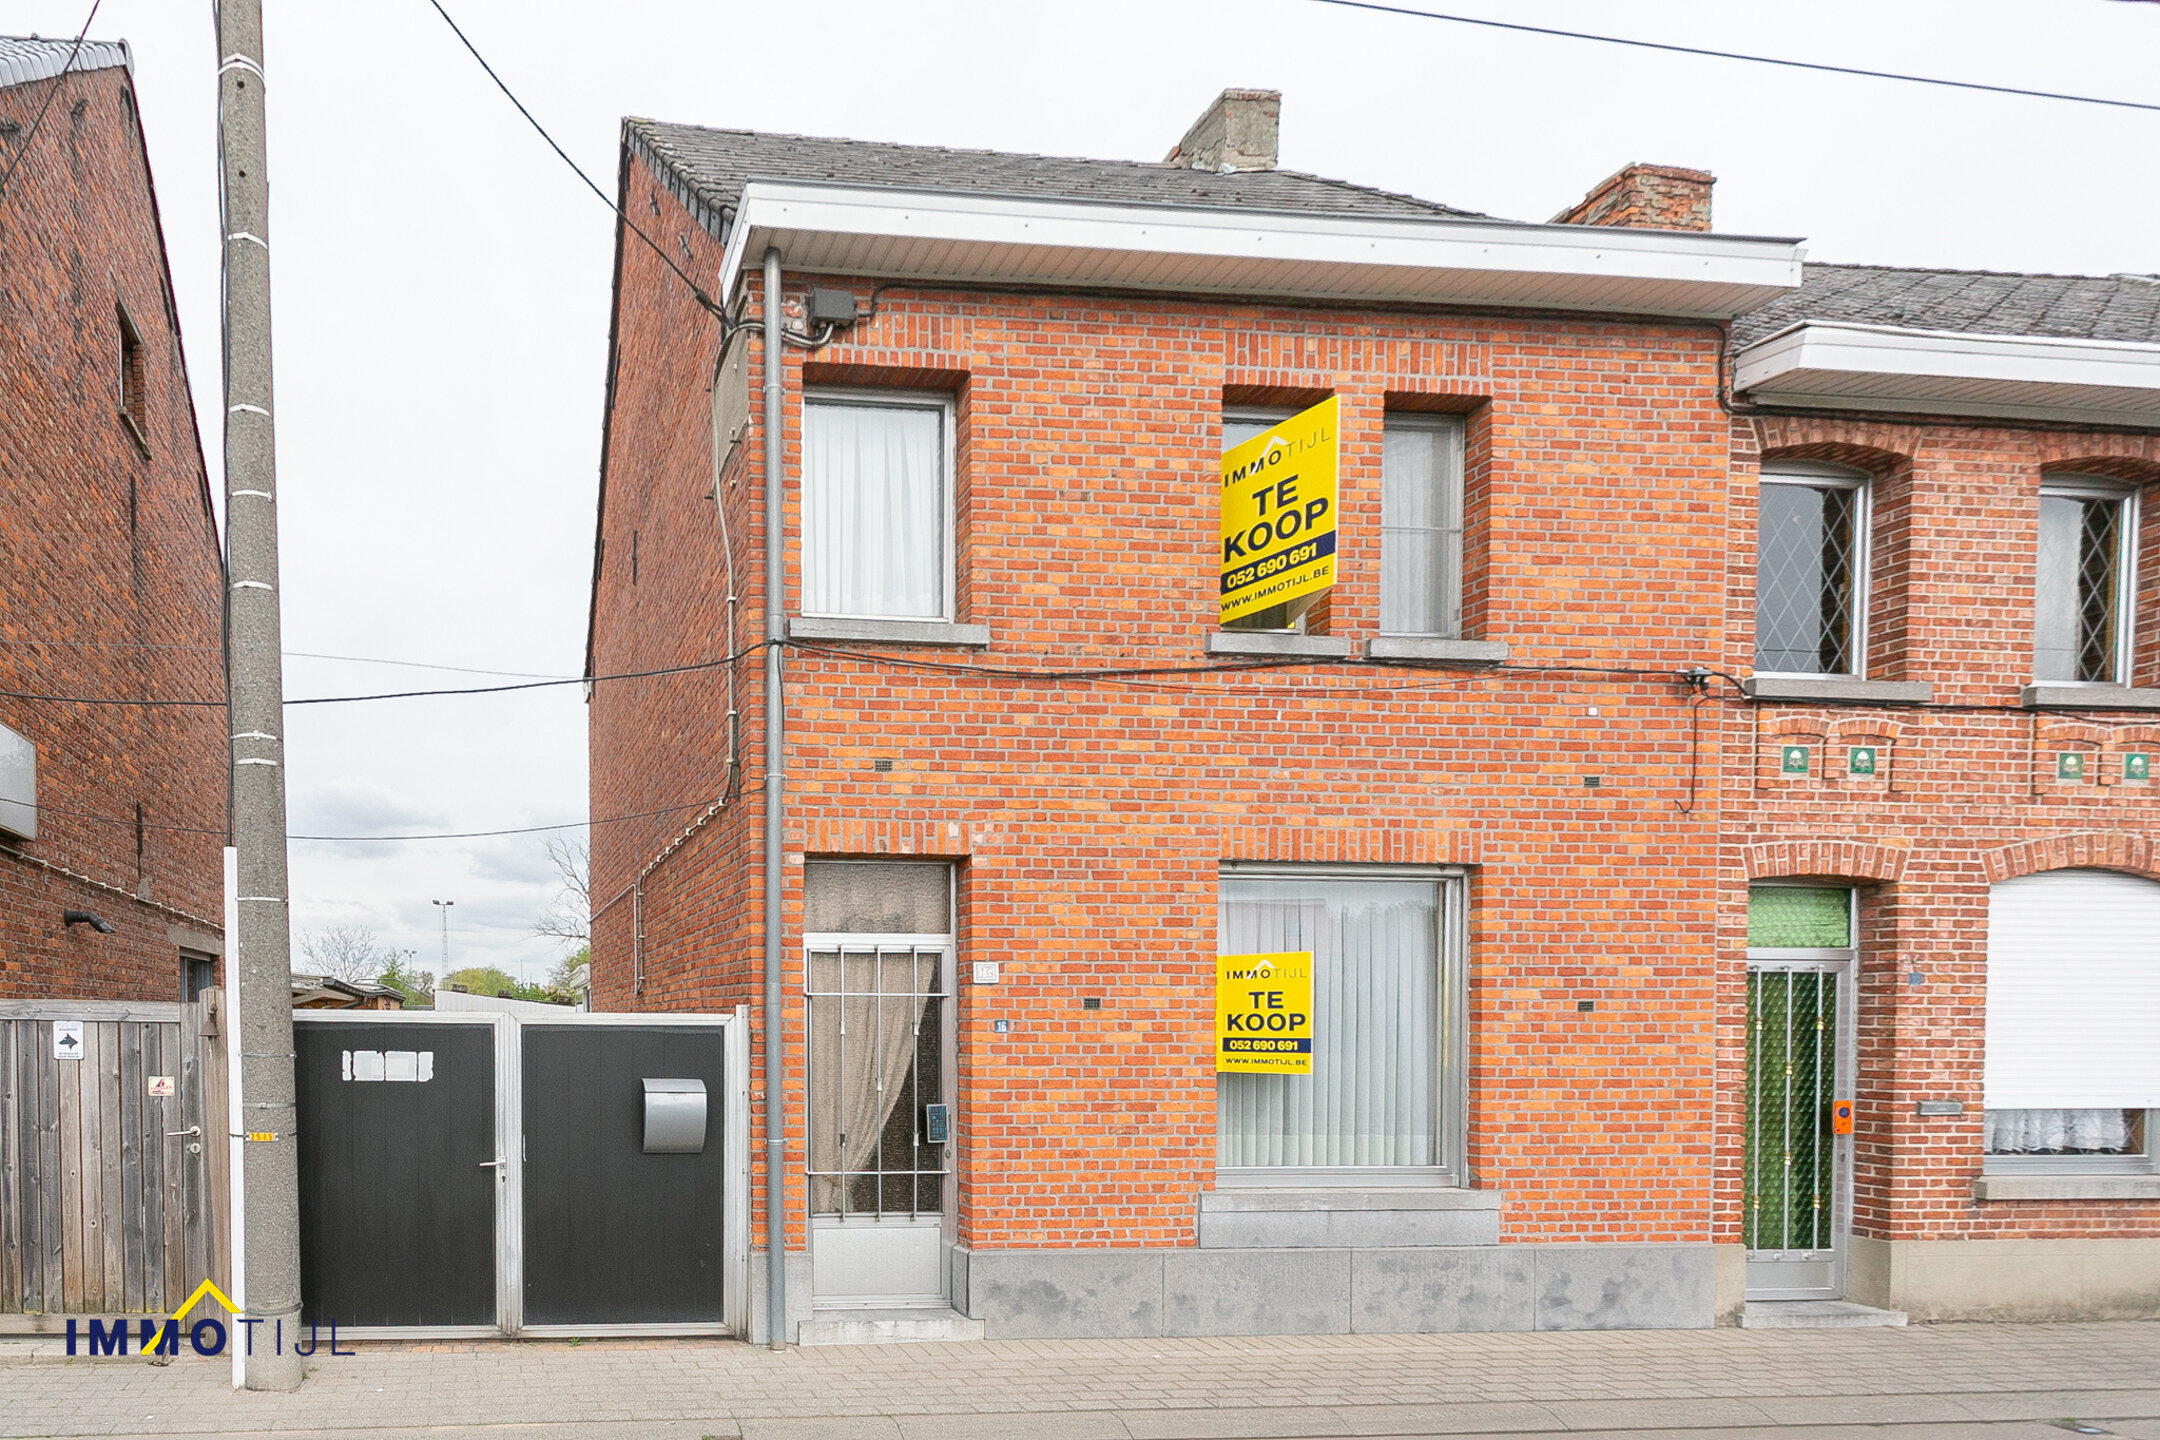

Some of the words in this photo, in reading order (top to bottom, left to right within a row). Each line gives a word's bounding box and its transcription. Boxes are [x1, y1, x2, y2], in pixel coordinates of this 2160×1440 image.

[1252, 474, 1299, 516] TE
[1223, 497, 1329, 563] KOOP
[1227, 567, 1255, 588] 052
[1257, 555, 1287, 577] 690
[1289, 542, 1317, 565] 691
[1220, 565, 1330, 612] WWW.IMMOTIJL.BE
[1248, 991, 1284, 1009] TE
[997, 1021, 1007, 1032] 16
[1226, 1013, 1306, 1031] KOOP
[1229, 1040, 1251, 1050] 052
[1252, 1040, 1276, 1051] 690
[1277, 1040, 1298, 1051] 691
[1225, 1058, 1307, 1066] WWW.IMMOTIJL.BE
